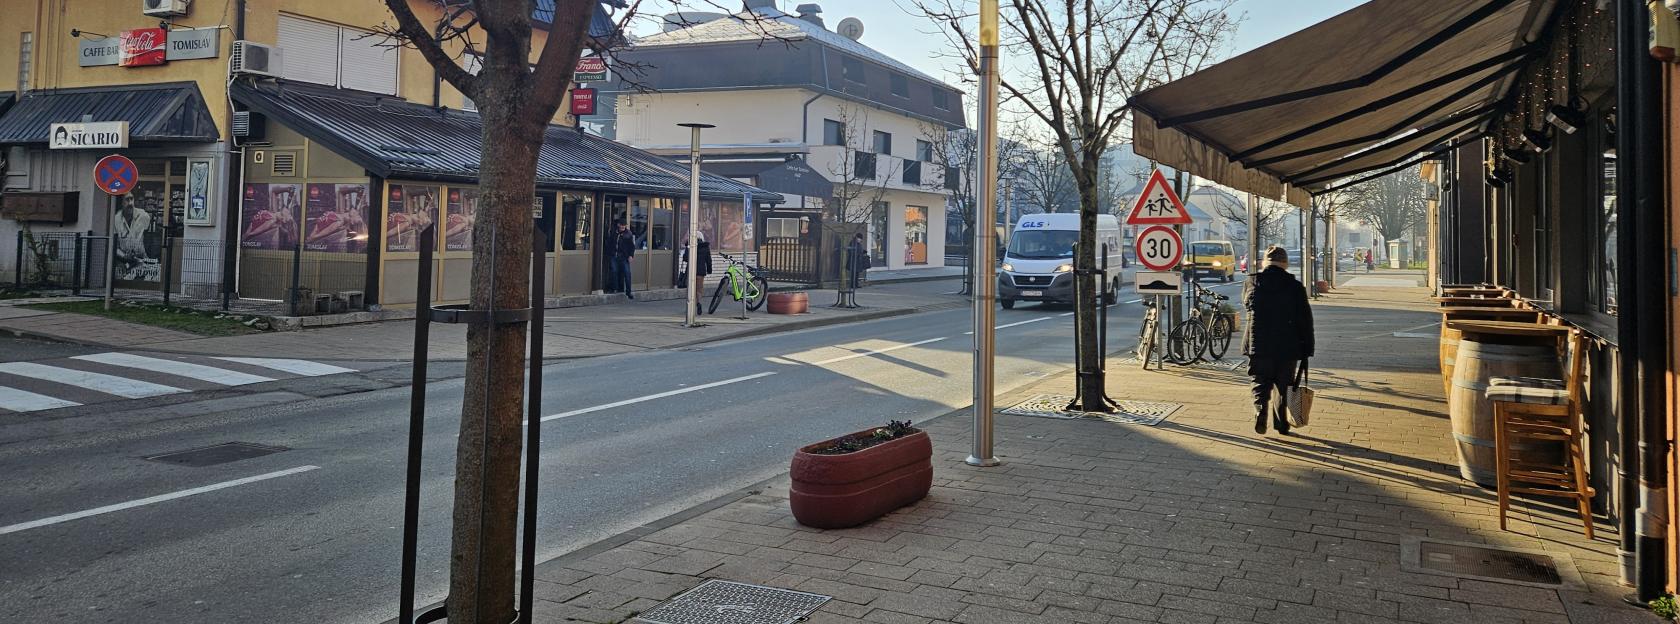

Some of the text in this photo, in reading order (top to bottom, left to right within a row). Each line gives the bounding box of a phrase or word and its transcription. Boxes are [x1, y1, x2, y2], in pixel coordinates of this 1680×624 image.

[83, 45, 119, 57] CAFFE BAR
[173, 38, 211, 51] TOMISLAV
[71, 132, 119, 146] SICARIO
[746, 197, 751, 218] P
[1147, 238, 1171, 259] 30
